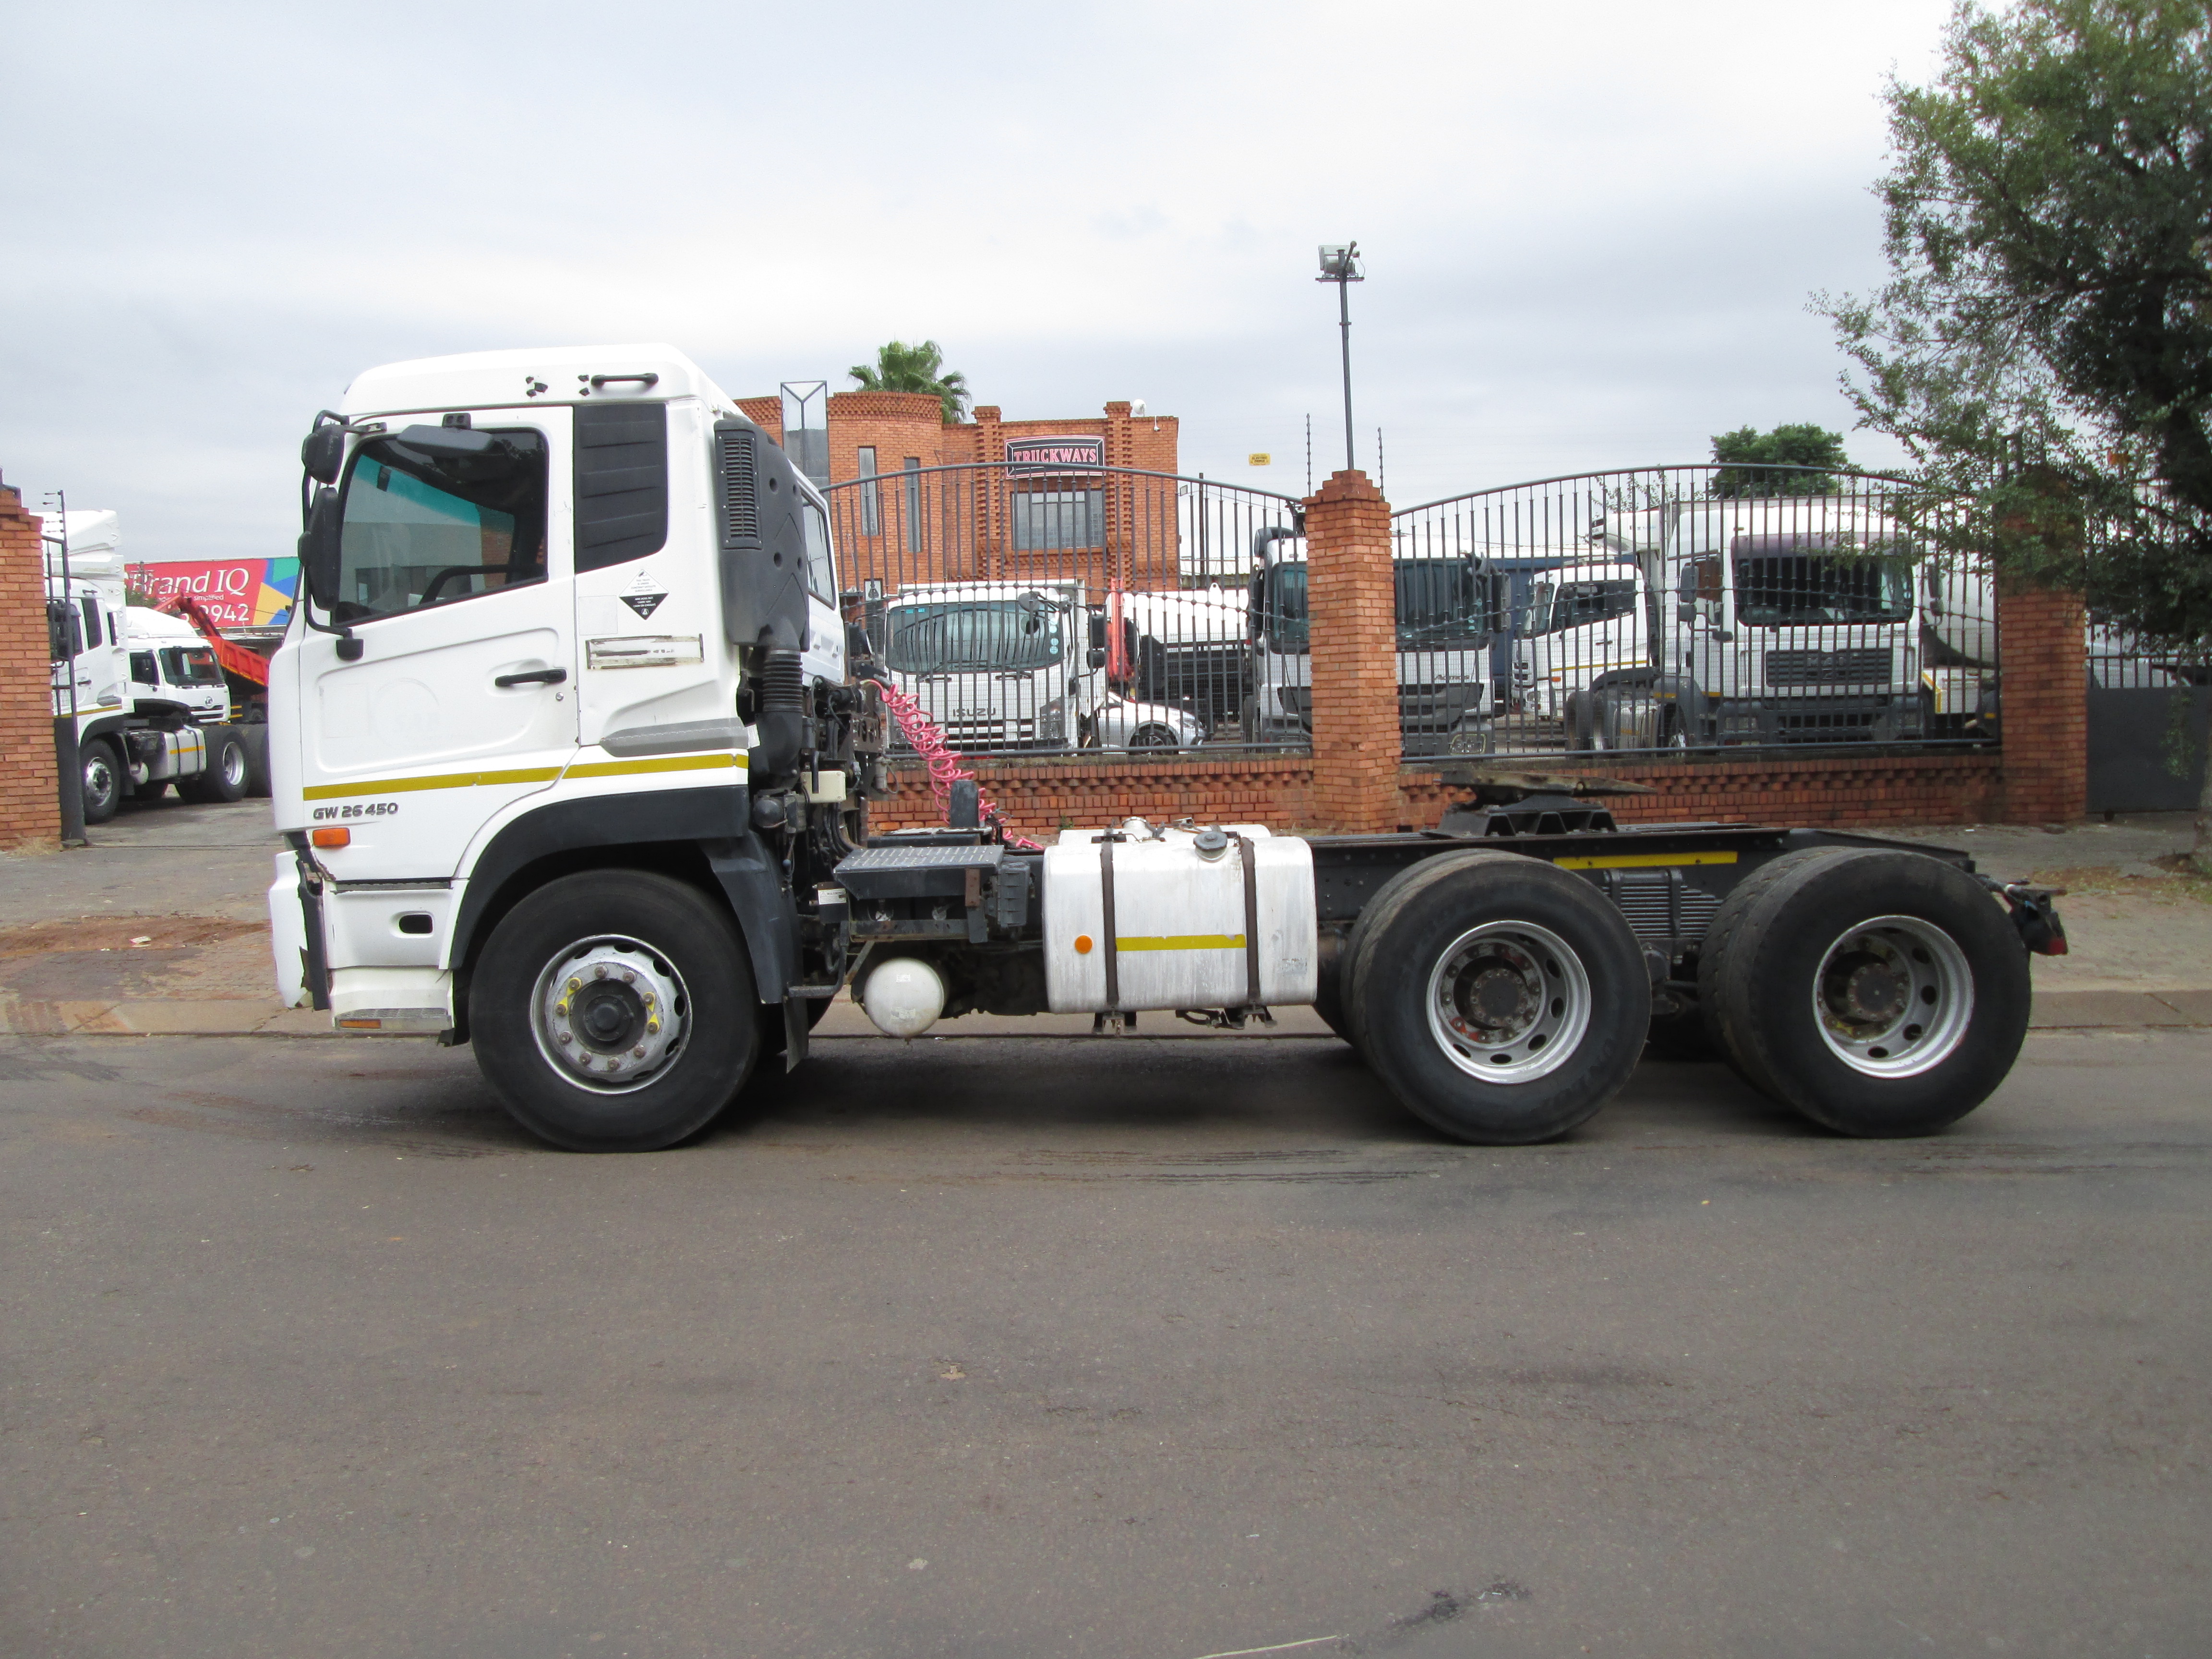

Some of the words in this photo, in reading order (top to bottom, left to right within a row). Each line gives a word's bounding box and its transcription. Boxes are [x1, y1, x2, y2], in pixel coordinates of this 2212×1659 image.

[1013, 448, 1097, 463] TRUCKWAYS
[214, 568, 250, 596] IQ
[952, 707, 996, 717] ISUZU
[313, 806, 339, 820] GW
[341, 805, 363, 817] 26
[365, 802, 399, 816] 450
